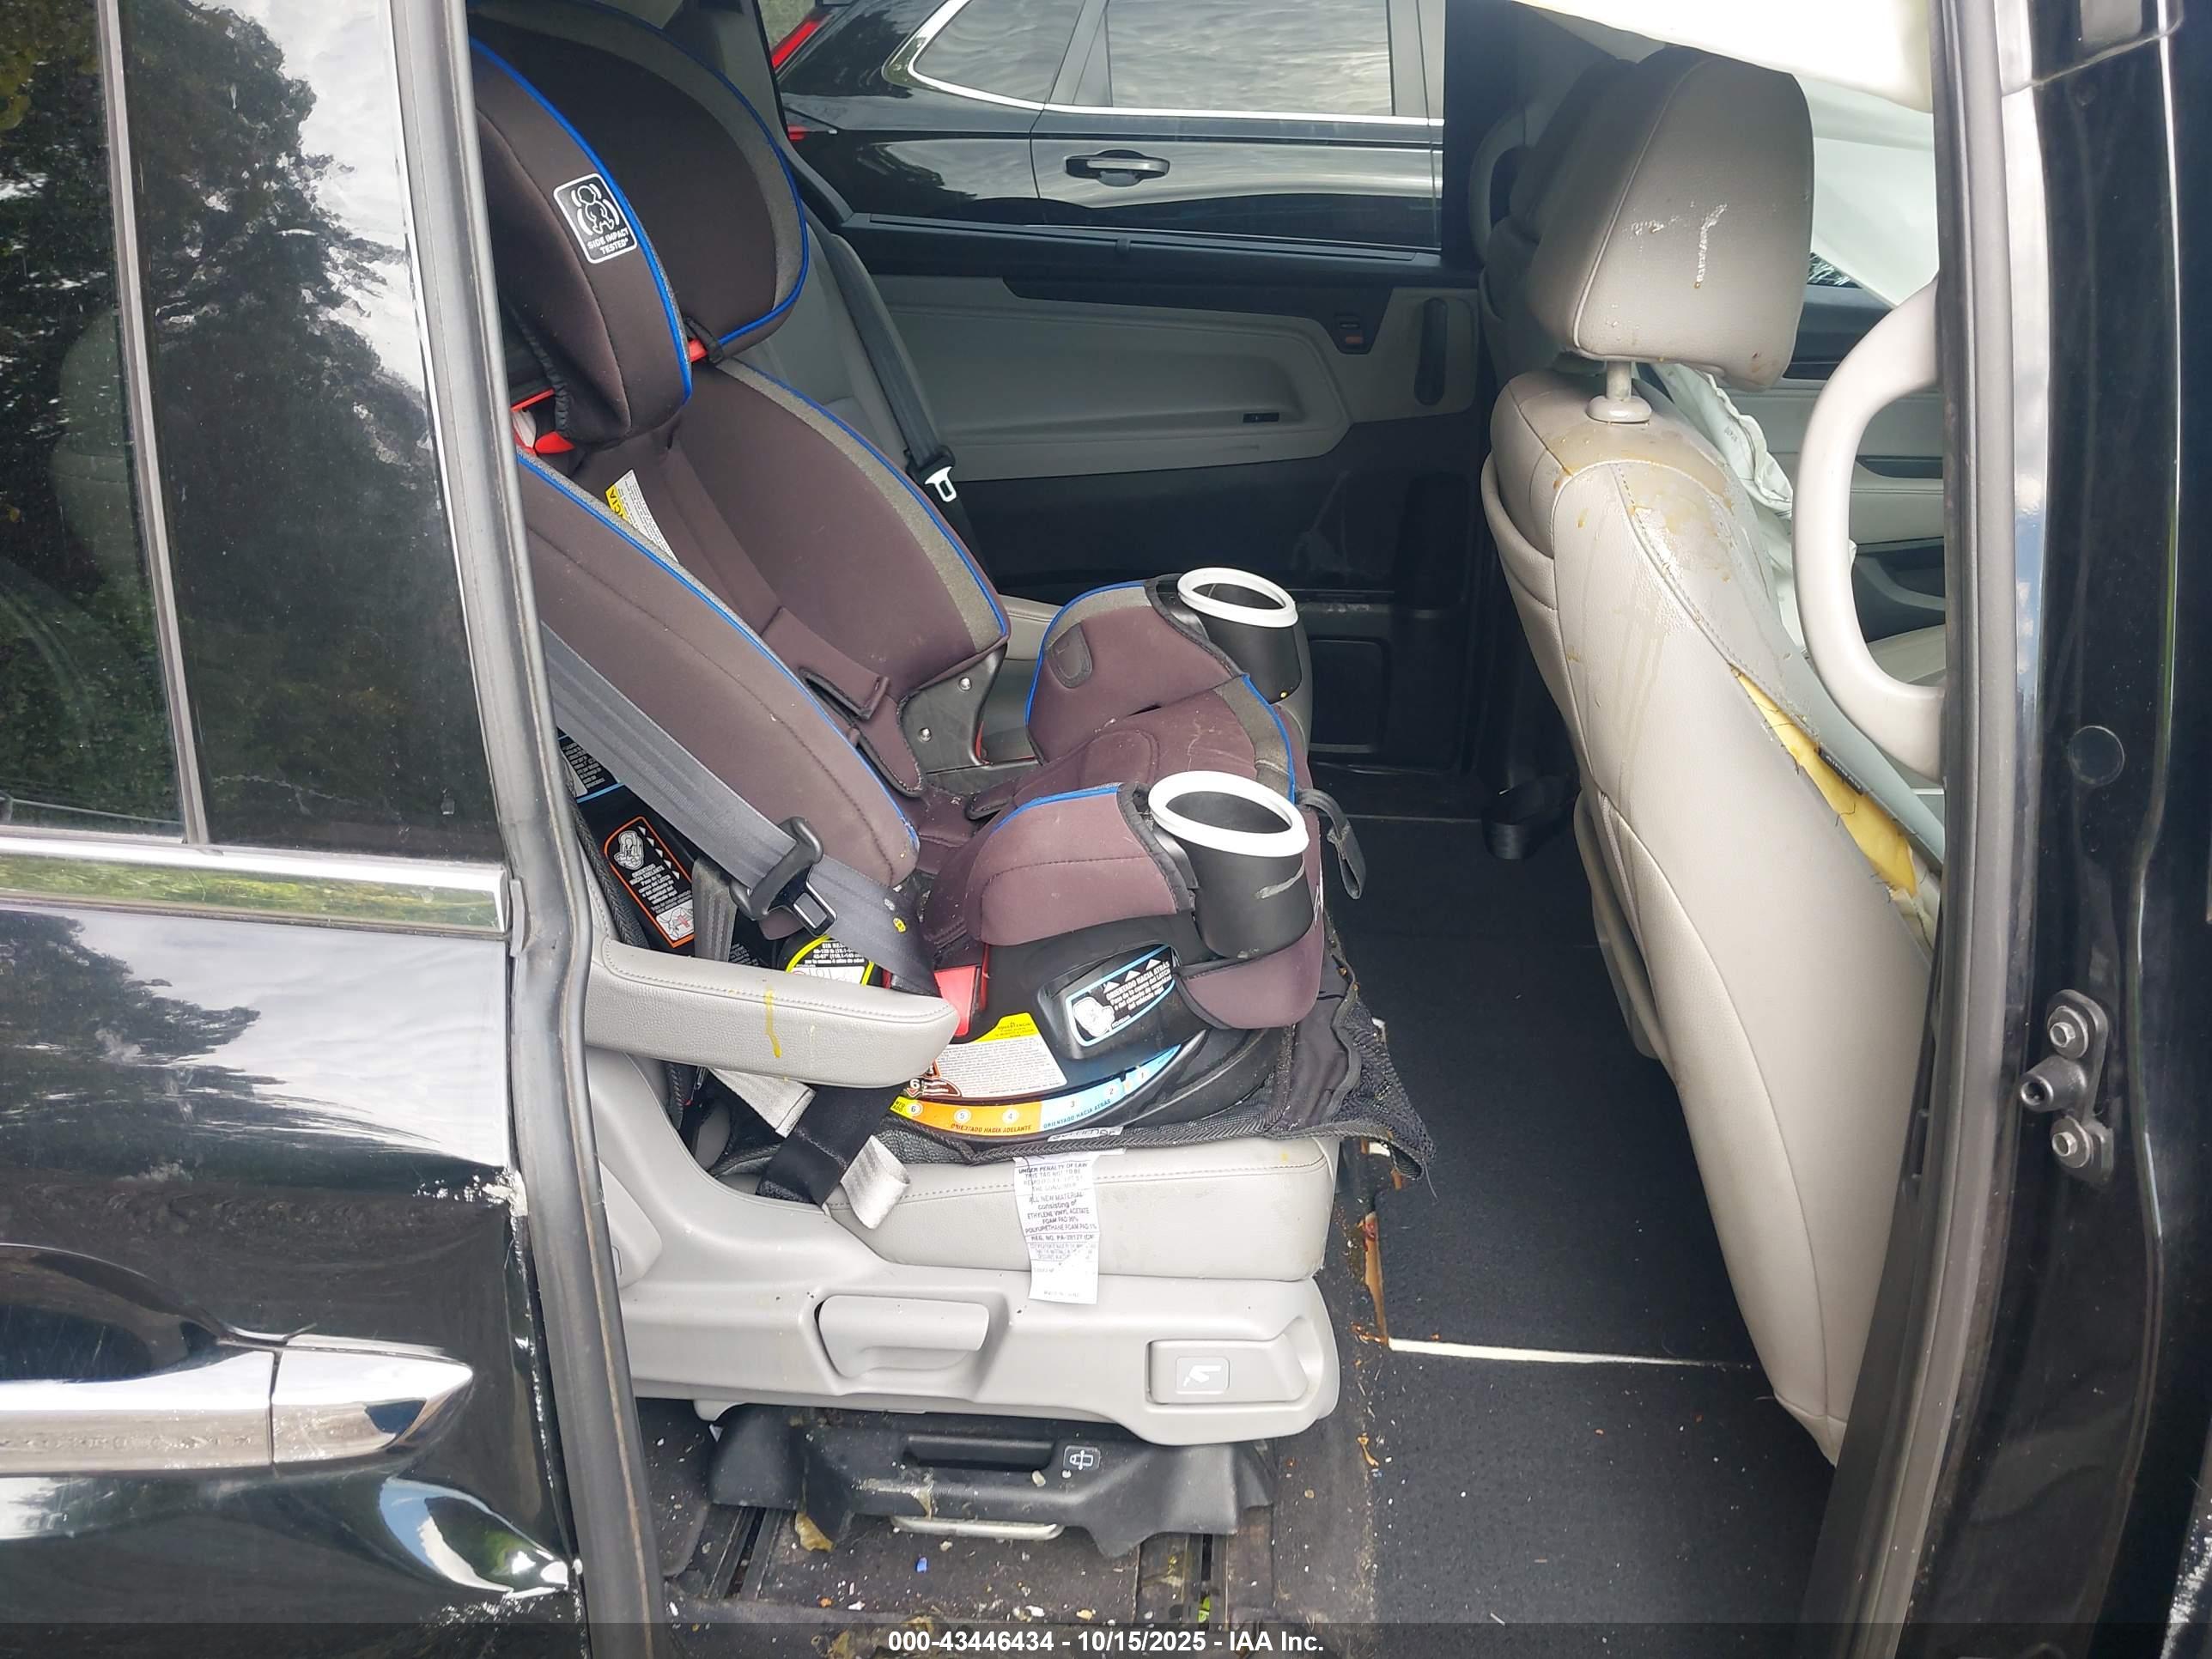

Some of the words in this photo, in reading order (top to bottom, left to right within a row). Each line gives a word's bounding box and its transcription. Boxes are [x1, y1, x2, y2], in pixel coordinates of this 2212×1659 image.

[587, 237, 605, 249] SIDE
[605, 228, 629, 242] IMPACT
[910, 1079, 921, 1089] 6
[1043, 1115, 1075, 1128] ORIENTADO
[1076, 1108, 1093, 1119] HACIA
[1055, 1192, 1083, 1200] MATERIAL
[1028, 1211, 1053, 1219] ETHYLENE
[1025, 1224, 1064, 1233] POLYURETHANE
